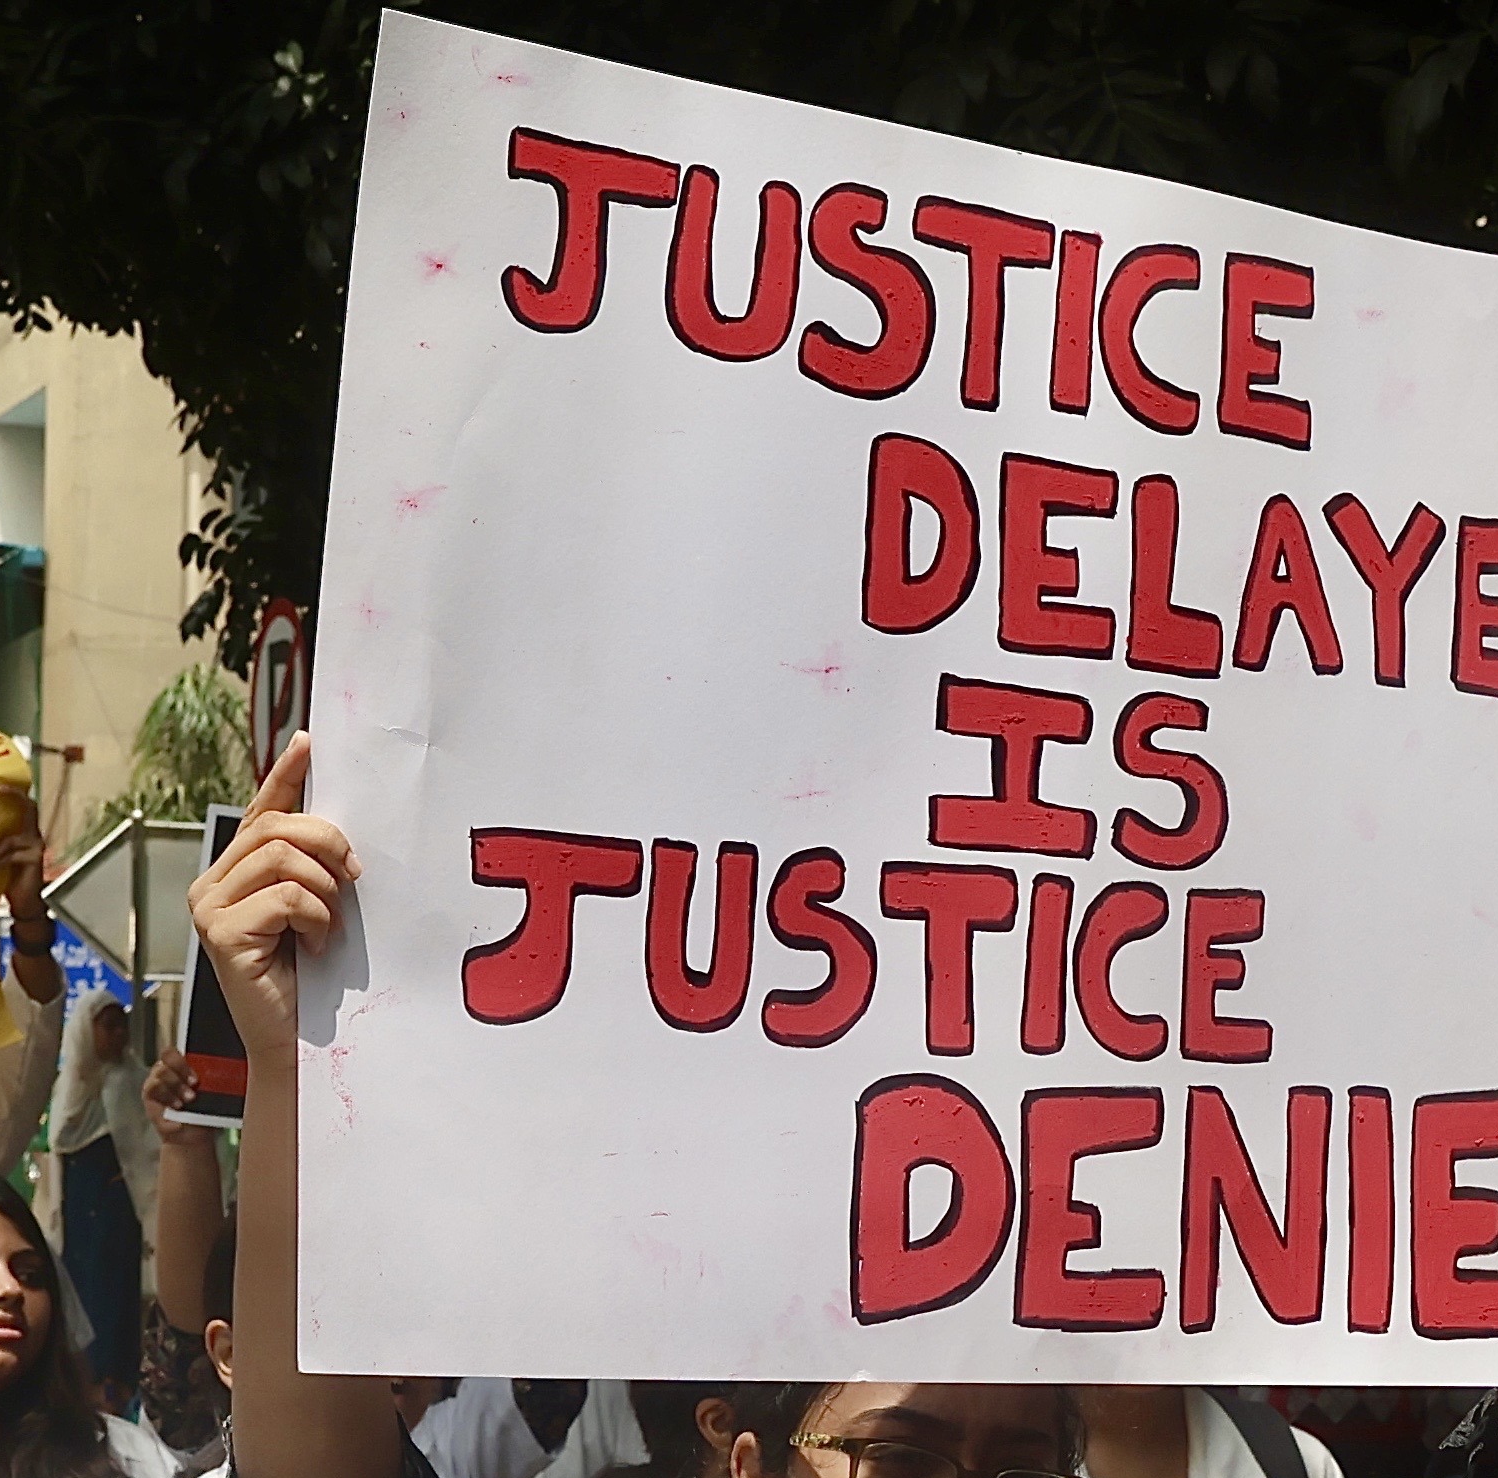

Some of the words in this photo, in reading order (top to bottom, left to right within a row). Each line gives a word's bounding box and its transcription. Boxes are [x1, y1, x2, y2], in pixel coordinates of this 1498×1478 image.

[500, 125, 1316, 453] JUSTICE
[926, 672, 1230, 872] IS
[461, 826, 1274, 1065] JUSTICE
